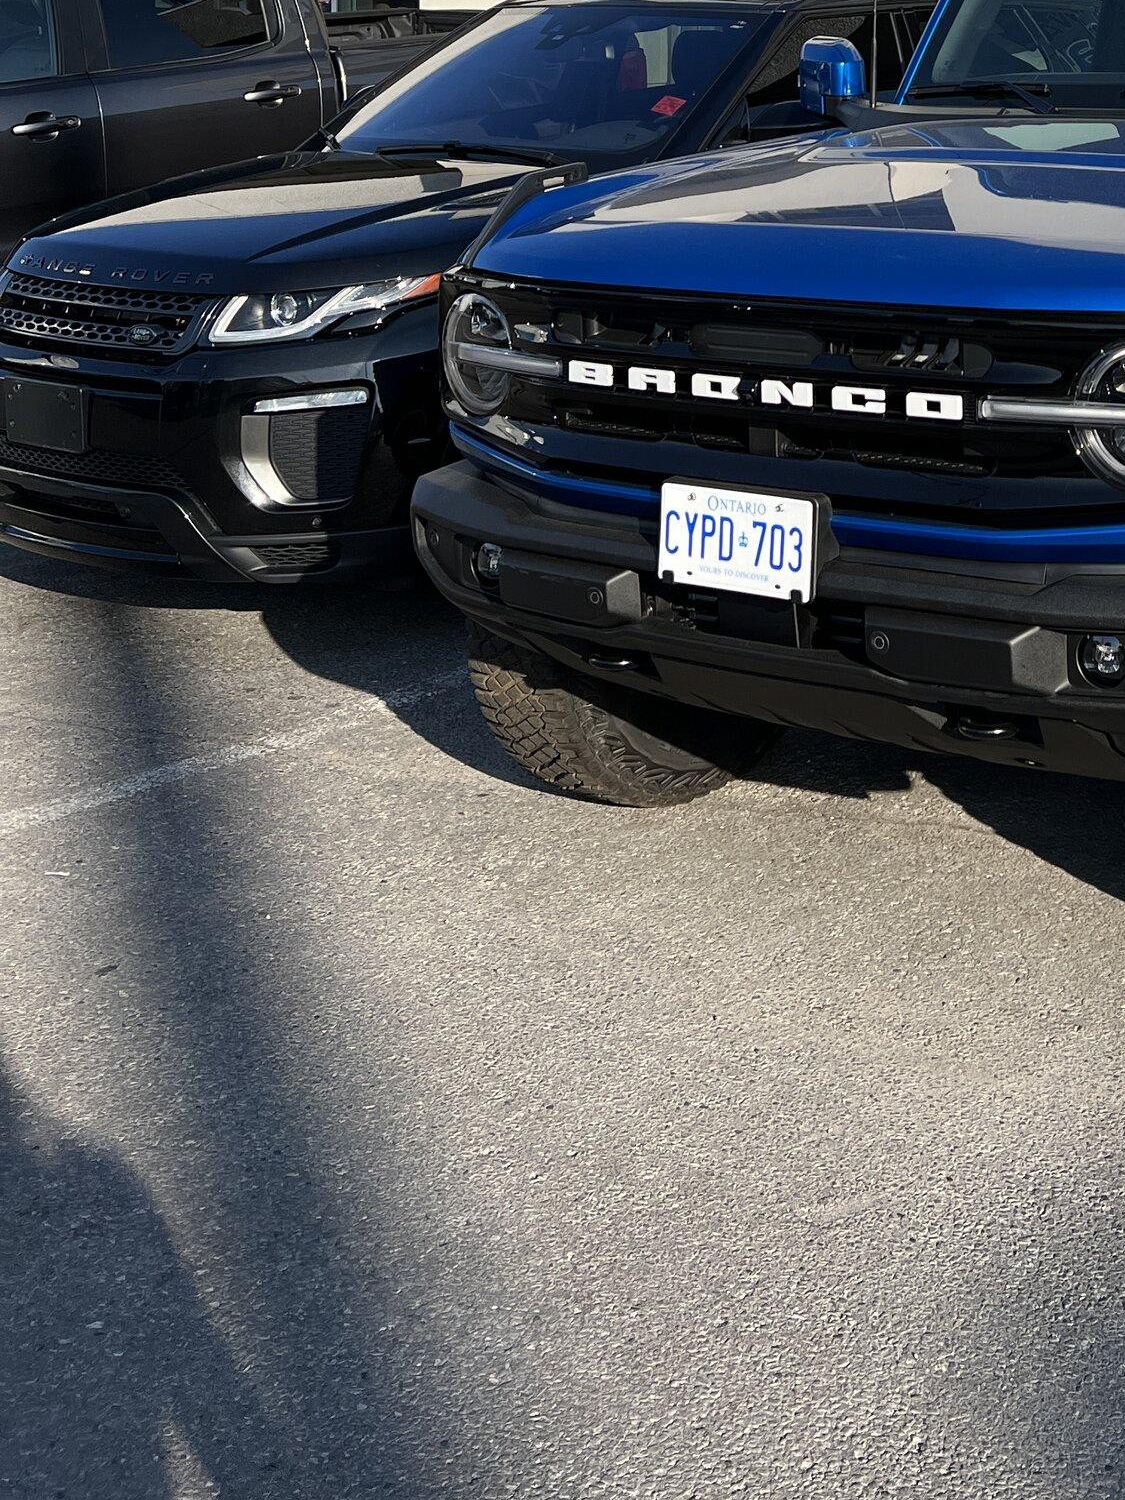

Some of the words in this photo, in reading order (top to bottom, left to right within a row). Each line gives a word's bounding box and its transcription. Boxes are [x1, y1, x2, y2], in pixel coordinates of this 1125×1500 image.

[110, 267, 216, 285] ROVER
[568, 359, 963, 421] BRONCO
[665, 510, 734, 561] CYPD
[752, 520, 803, 573] 703
[735, 570, 769, 582] DISCOVER
